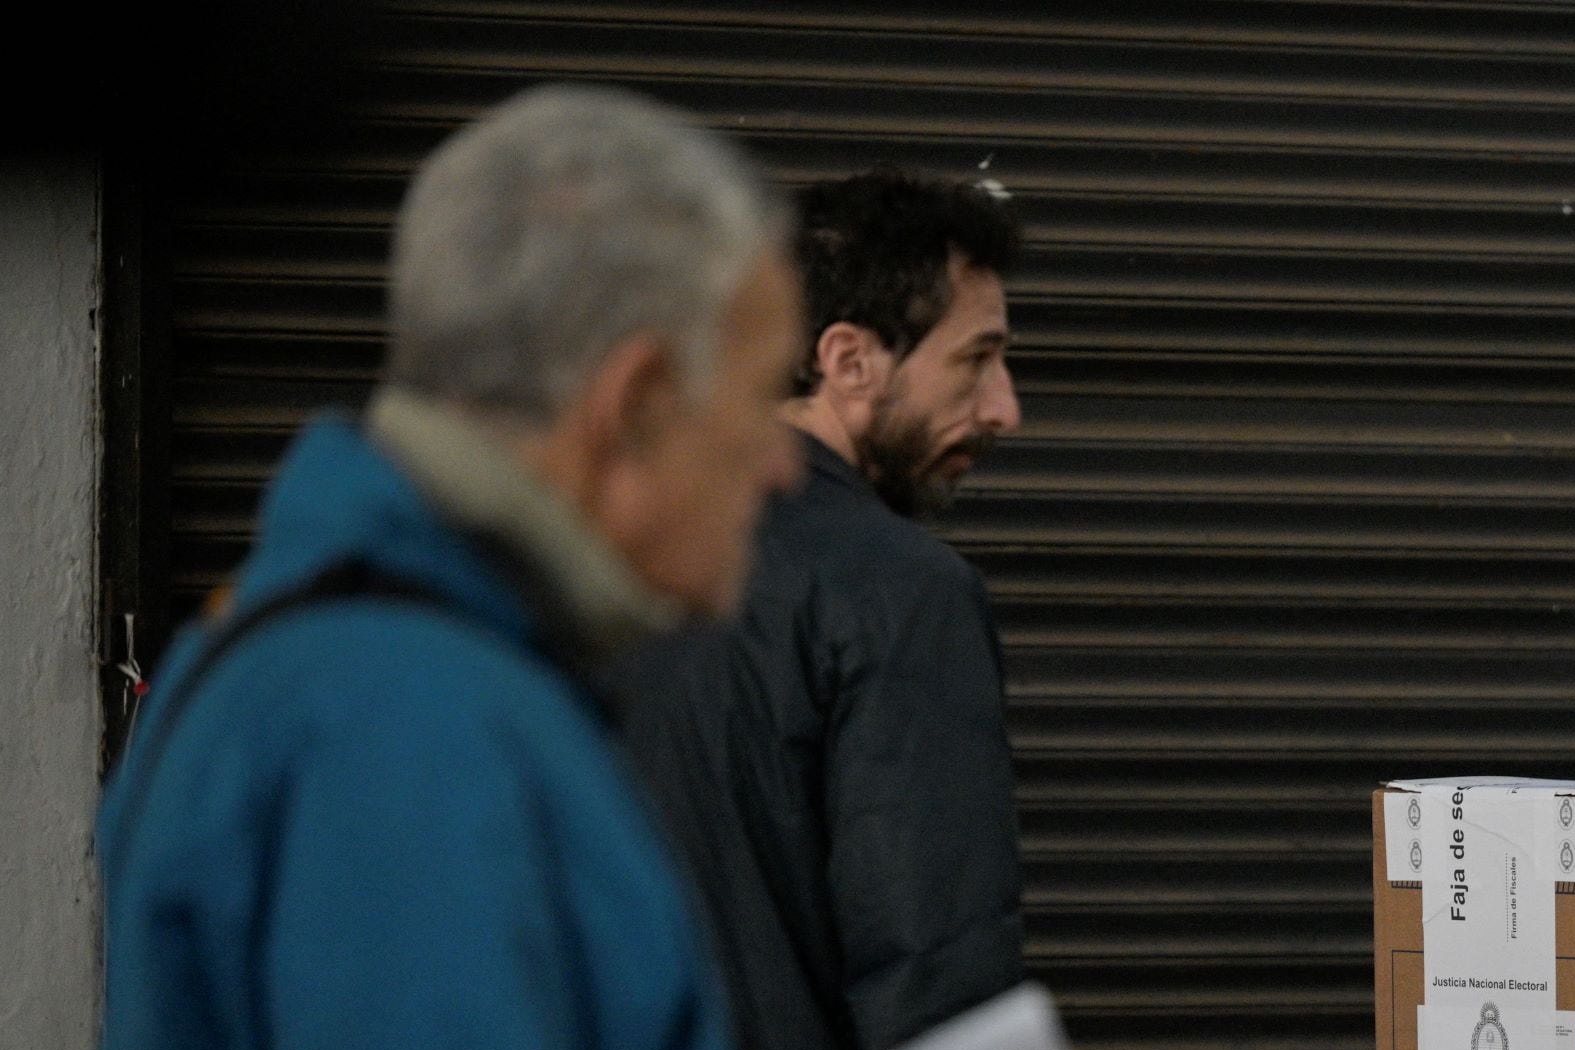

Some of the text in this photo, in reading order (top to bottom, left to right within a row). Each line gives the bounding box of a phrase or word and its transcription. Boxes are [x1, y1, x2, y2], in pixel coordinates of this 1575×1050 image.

[1449, 829, 1465, 860] de
[1450, 869, 1469, 921] Faja
[1509, 856, 1518, 939] Firma de Fiscales
[1432, 976, 1548, 992] Justicia Nacional Electoral
